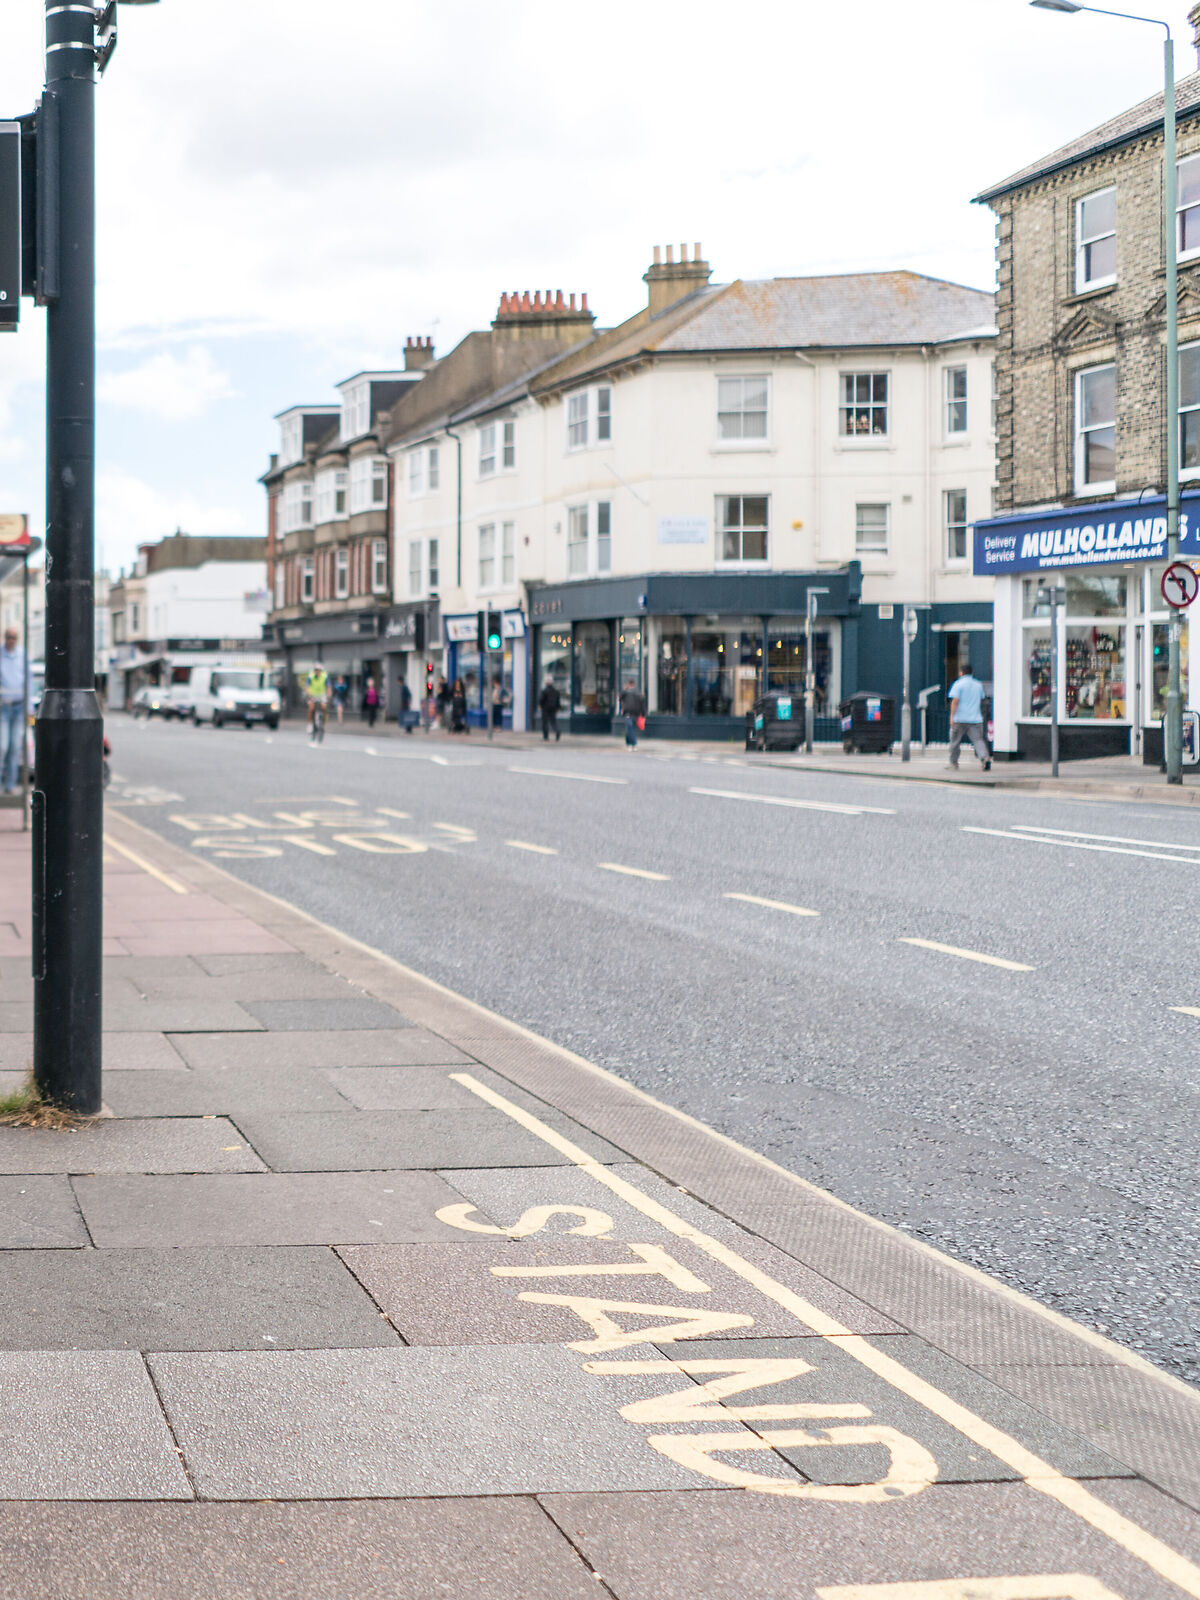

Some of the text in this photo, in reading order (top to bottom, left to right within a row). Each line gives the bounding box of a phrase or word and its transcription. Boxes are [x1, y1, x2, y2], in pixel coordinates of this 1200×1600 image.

[984, 536, 1017, 550] Delivery
[985, 550, 1015, 564] Service
[1039, 543, 1163, 568] www.mulhollandwines.co.uk
[167, 811, 389, 831] BUS
[435, 1204, 940, 1504] STAND
